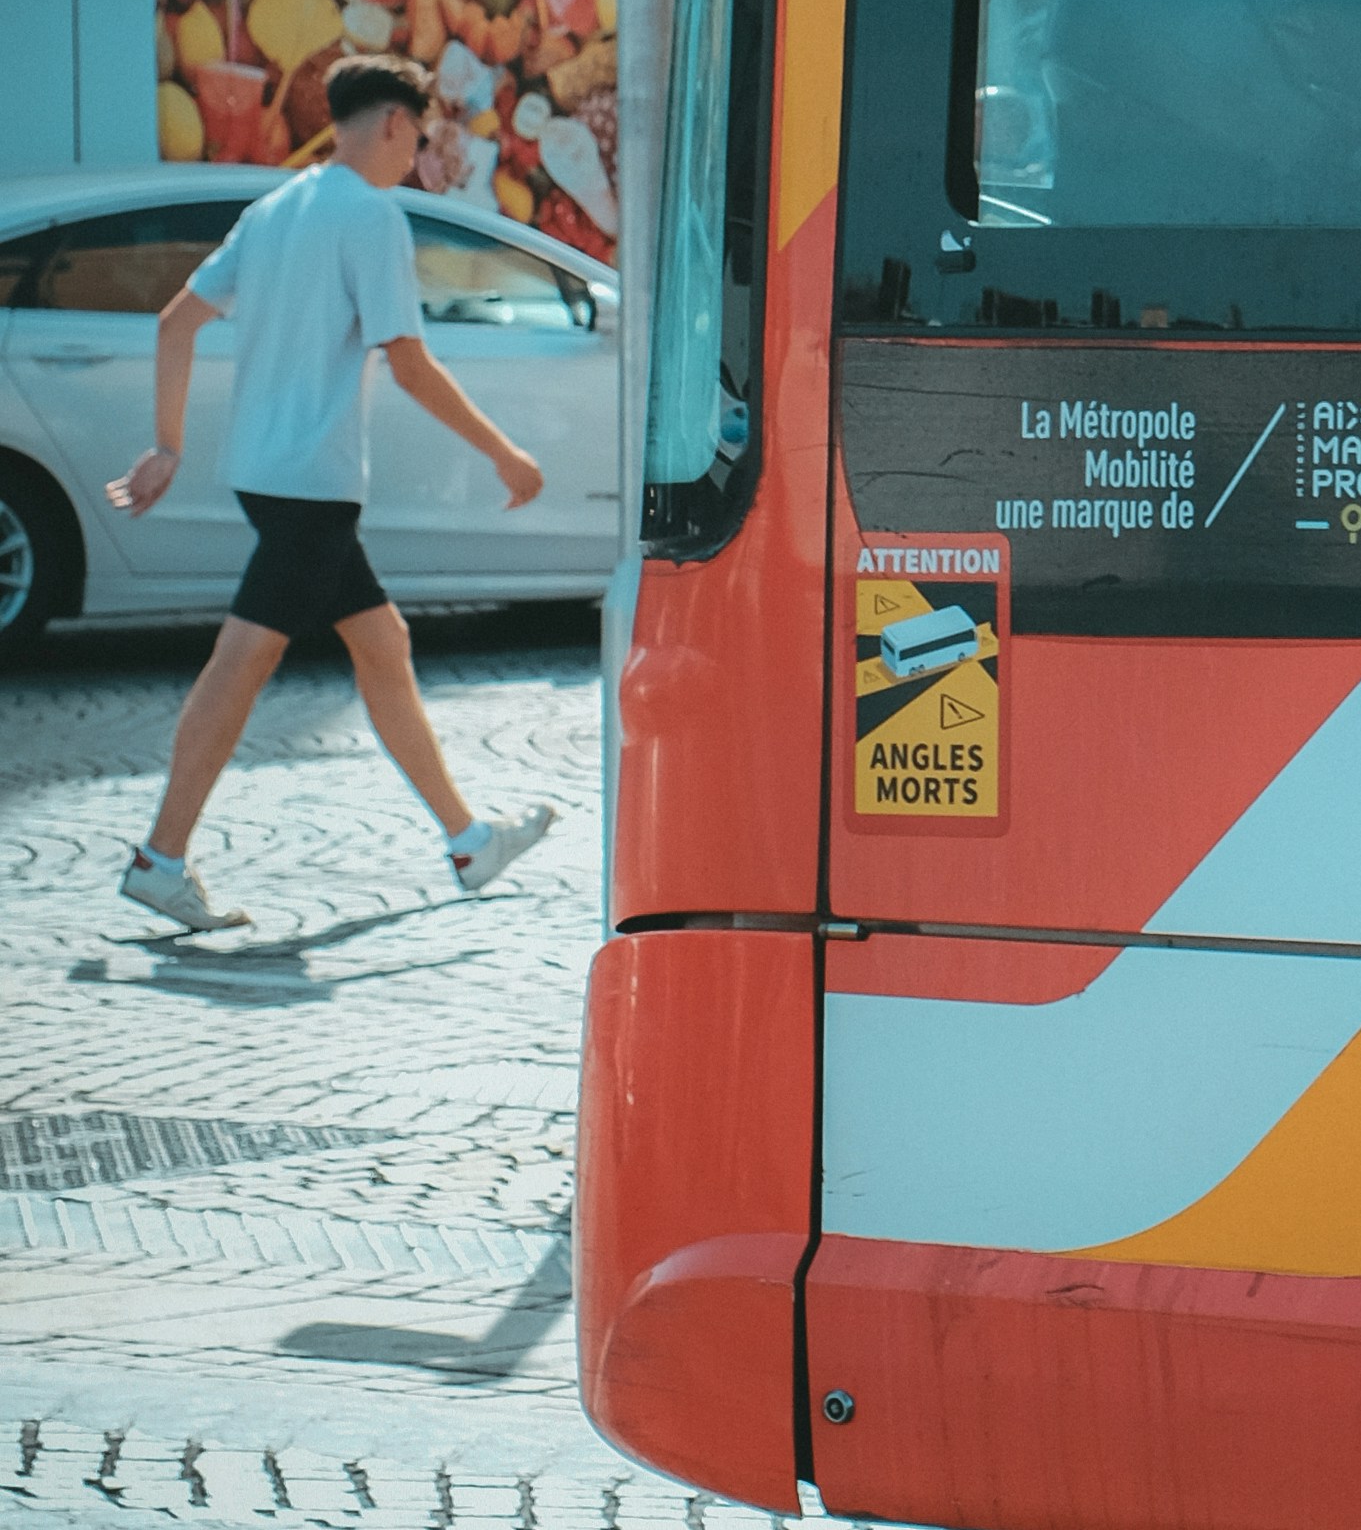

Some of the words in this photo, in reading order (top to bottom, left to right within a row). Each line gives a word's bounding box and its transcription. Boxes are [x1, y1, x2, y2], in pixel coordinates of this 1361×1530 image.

[1020, 401, 1050, 440] La
[1060, 400, 1195, 448] Métropole
[1085, 450, 1195, 489] Mobilité
[996, 502, 1043, 530] une
[1051, 501, 1156, 538] marque
[1161, 497, 1194, 530] de
[856, 547, 1001, 575] ATTENTION
[870, 742, 984, 773] ANGLES
[876, 776, 978, 806] MORTS
